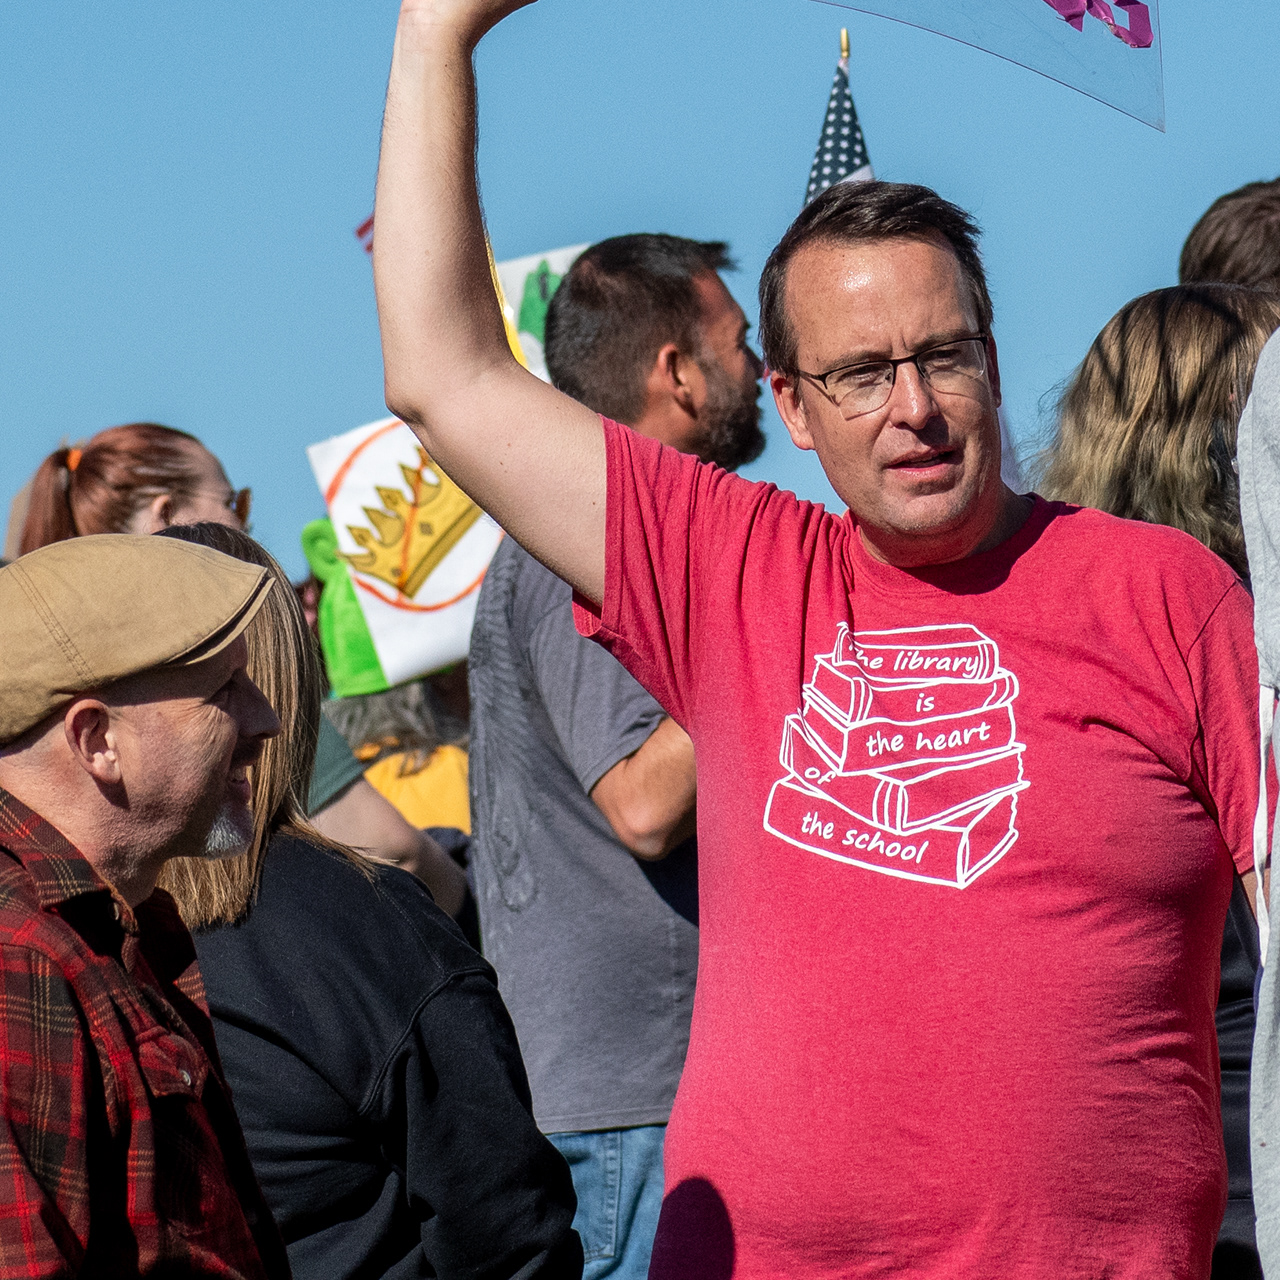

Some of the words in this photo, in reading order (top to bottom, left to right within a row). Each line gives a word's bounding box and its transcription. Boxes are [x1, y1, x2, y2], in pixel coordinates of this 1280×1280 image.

[893, 650, 979, 679] library
[915, 692, 936, 713] is
[866, 730, 905, 757] the
[915, 721, 991, 752] heart
[801, 811, 835, 840] the
[841, 828, 930, 864] school
